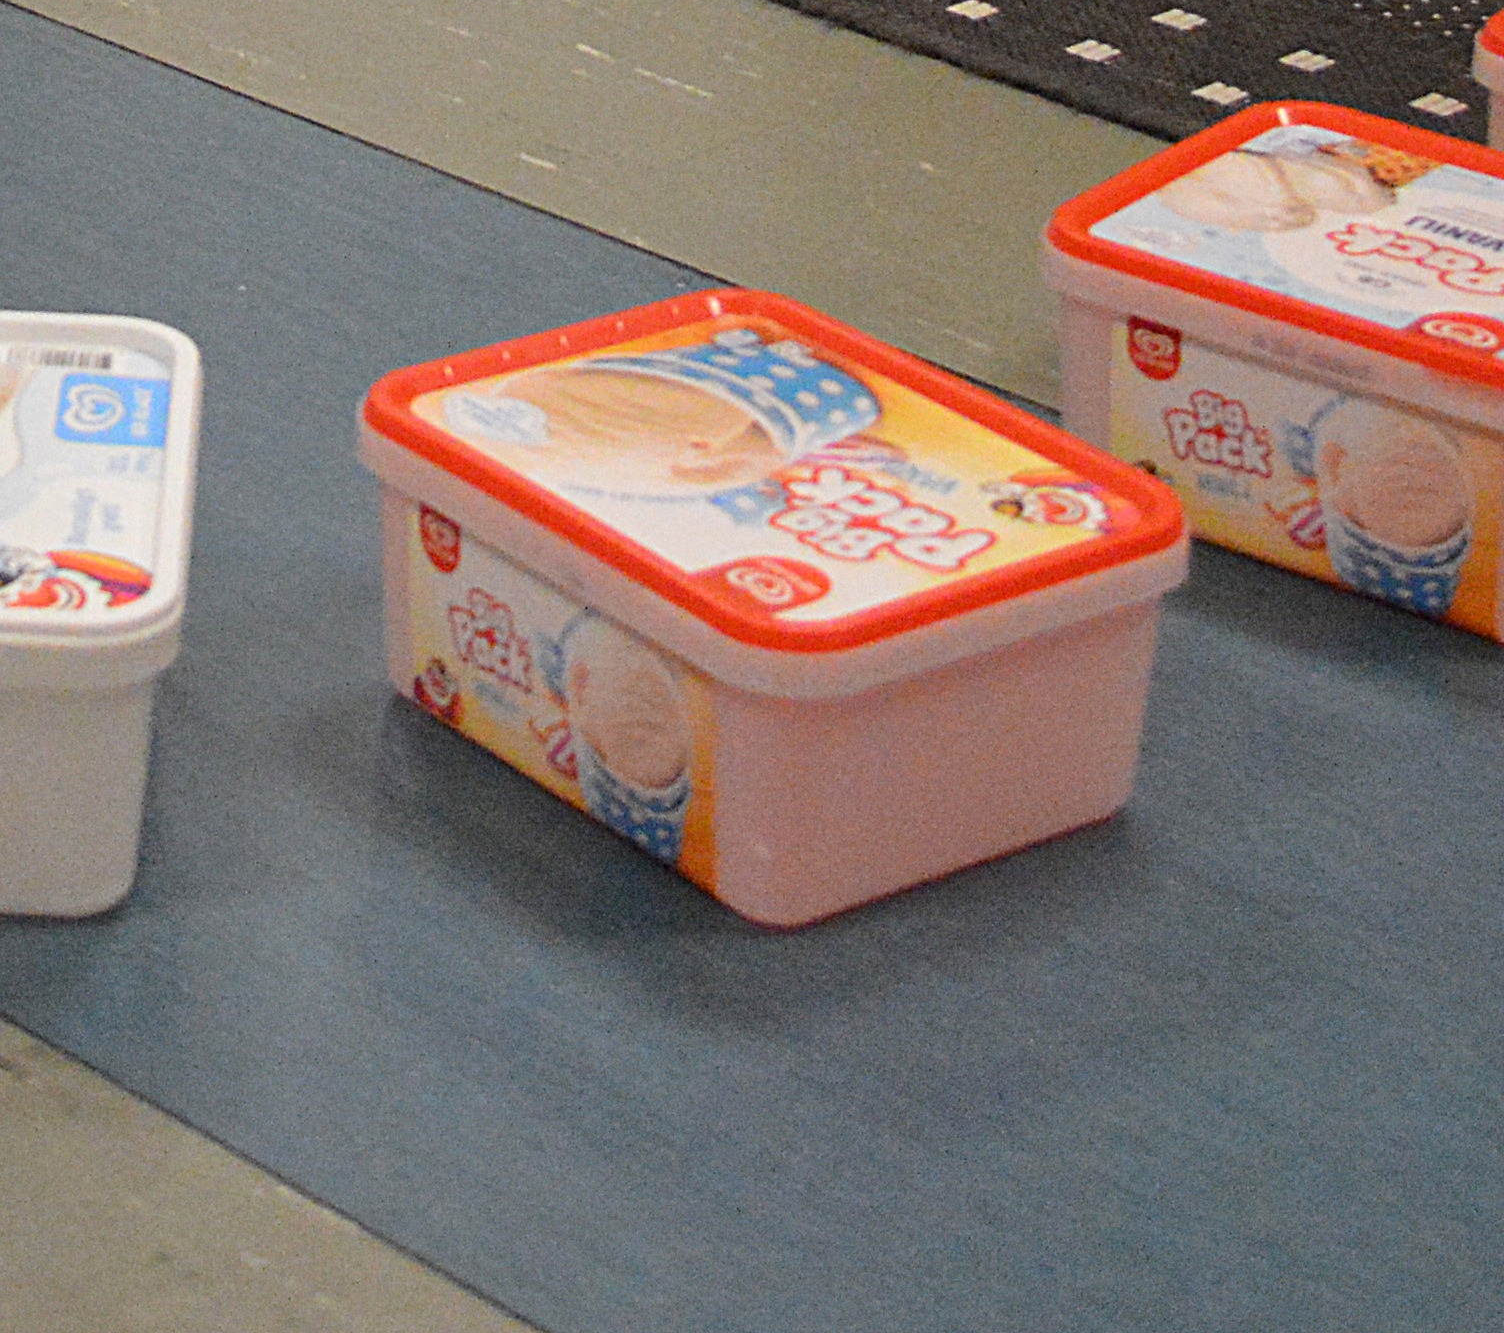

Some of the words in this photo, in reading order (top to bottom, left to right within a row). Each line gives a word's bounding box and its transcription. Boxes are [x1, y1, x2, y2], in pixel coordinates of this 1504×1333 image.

[1164, 408, 1275, 479] Pack
[1190, 389, 1251, 436] Big
[768, 504, 895, 562] Big
[783, 464, 999, 574] Pack
